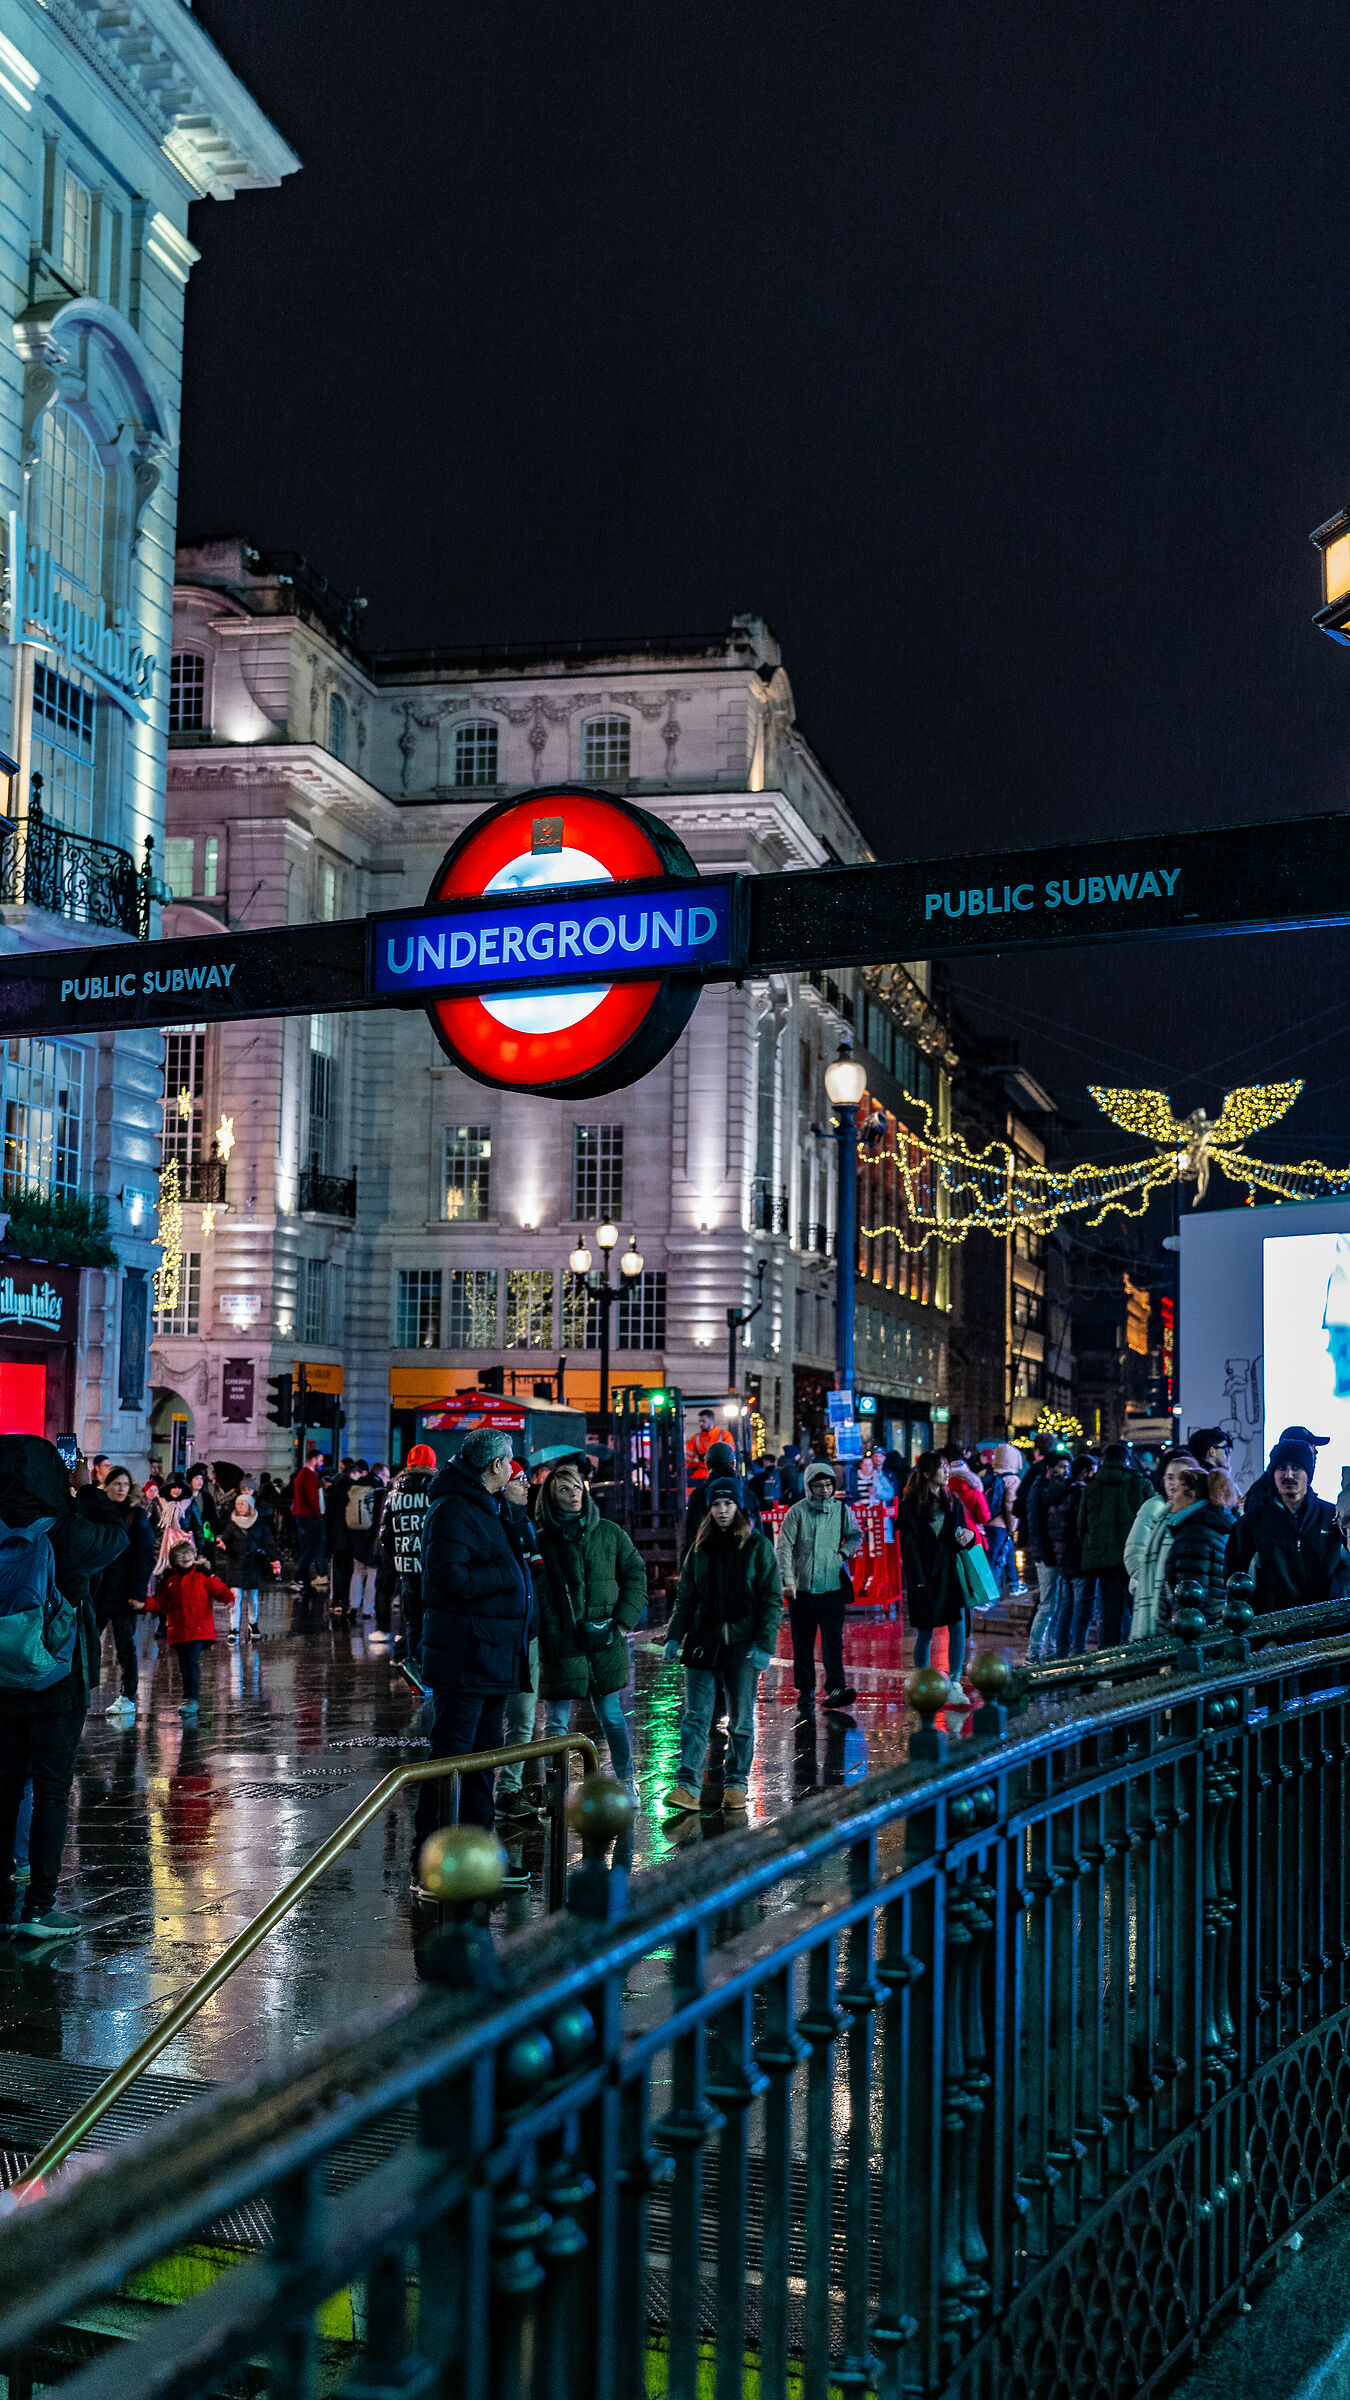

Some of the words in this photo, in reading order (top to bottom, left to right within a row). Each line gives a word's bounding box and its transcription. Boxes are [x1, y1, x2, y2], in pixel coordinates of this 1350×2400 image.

[927, 883, 1035, 920] PUBLIC
[1043, 868, 1182, 908] SUBWAY
[387, 906, 718, 974] UNDERGROUND
[60, 973, 137, 1002] PUBLIC
[142, 963, 236, 995] SUBWAY
[0, 1276, 63, 1325] illywhites
